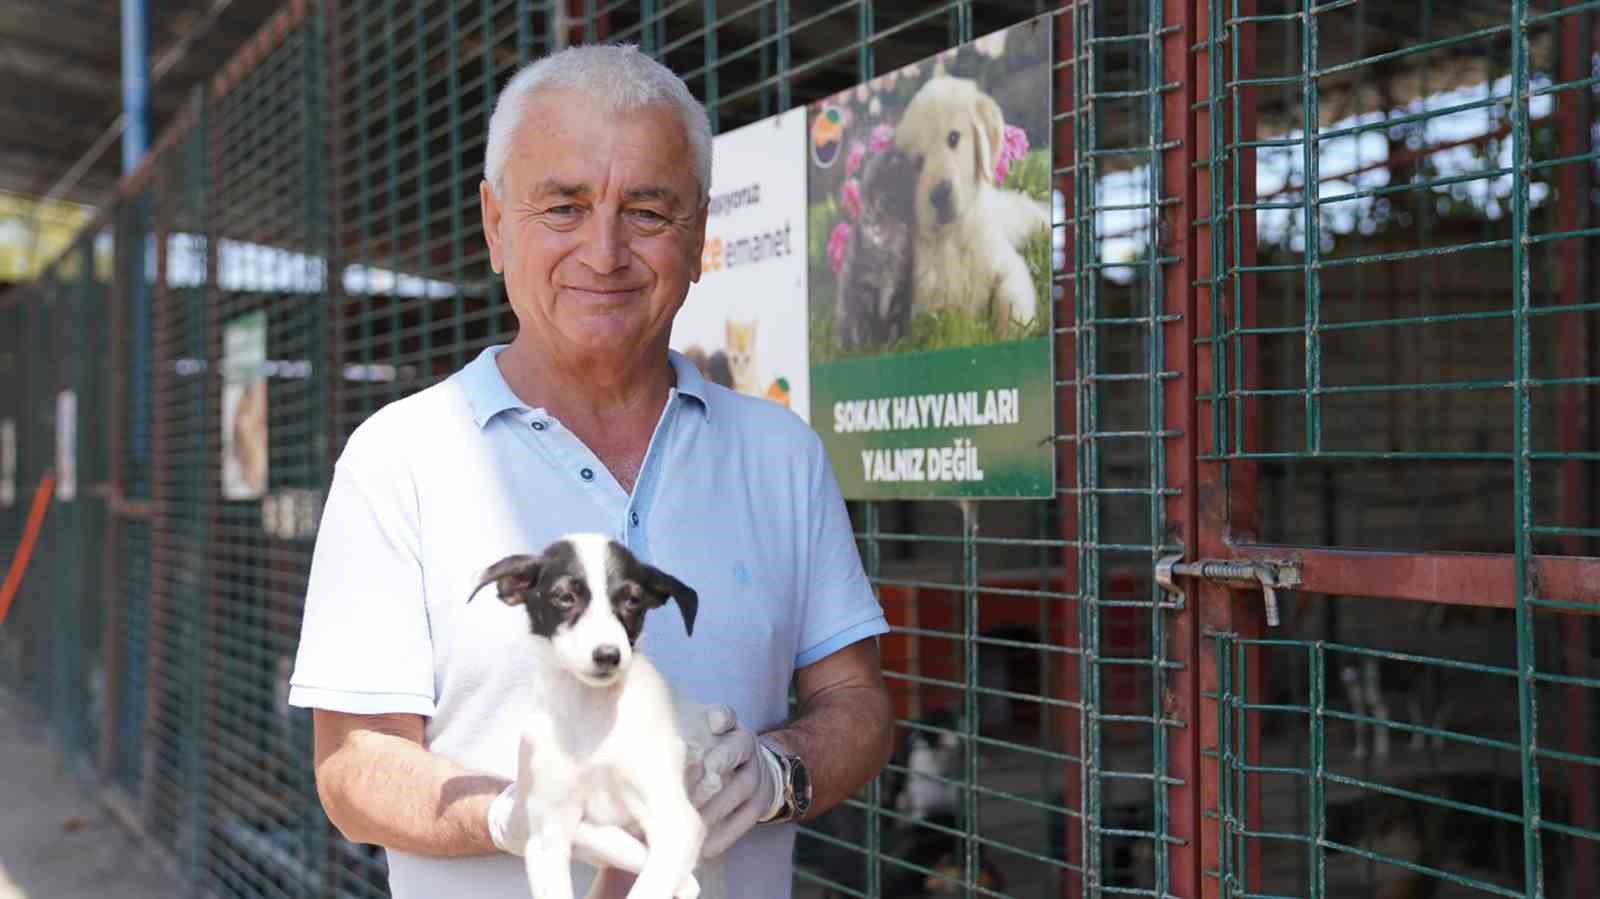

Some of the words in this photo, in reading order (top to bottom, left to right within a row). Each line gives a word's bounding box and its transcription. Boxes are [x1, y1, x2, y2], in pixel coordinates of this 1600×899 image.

[724, 219, 791, 268] emanet
[833, 397, 891, 433] SOKAK
[893, 388, 1019, 429] HAYVANLARI
[861, 447, 925, 482] YALNIZ
[927, 437, 984, 482] DEĞİL
